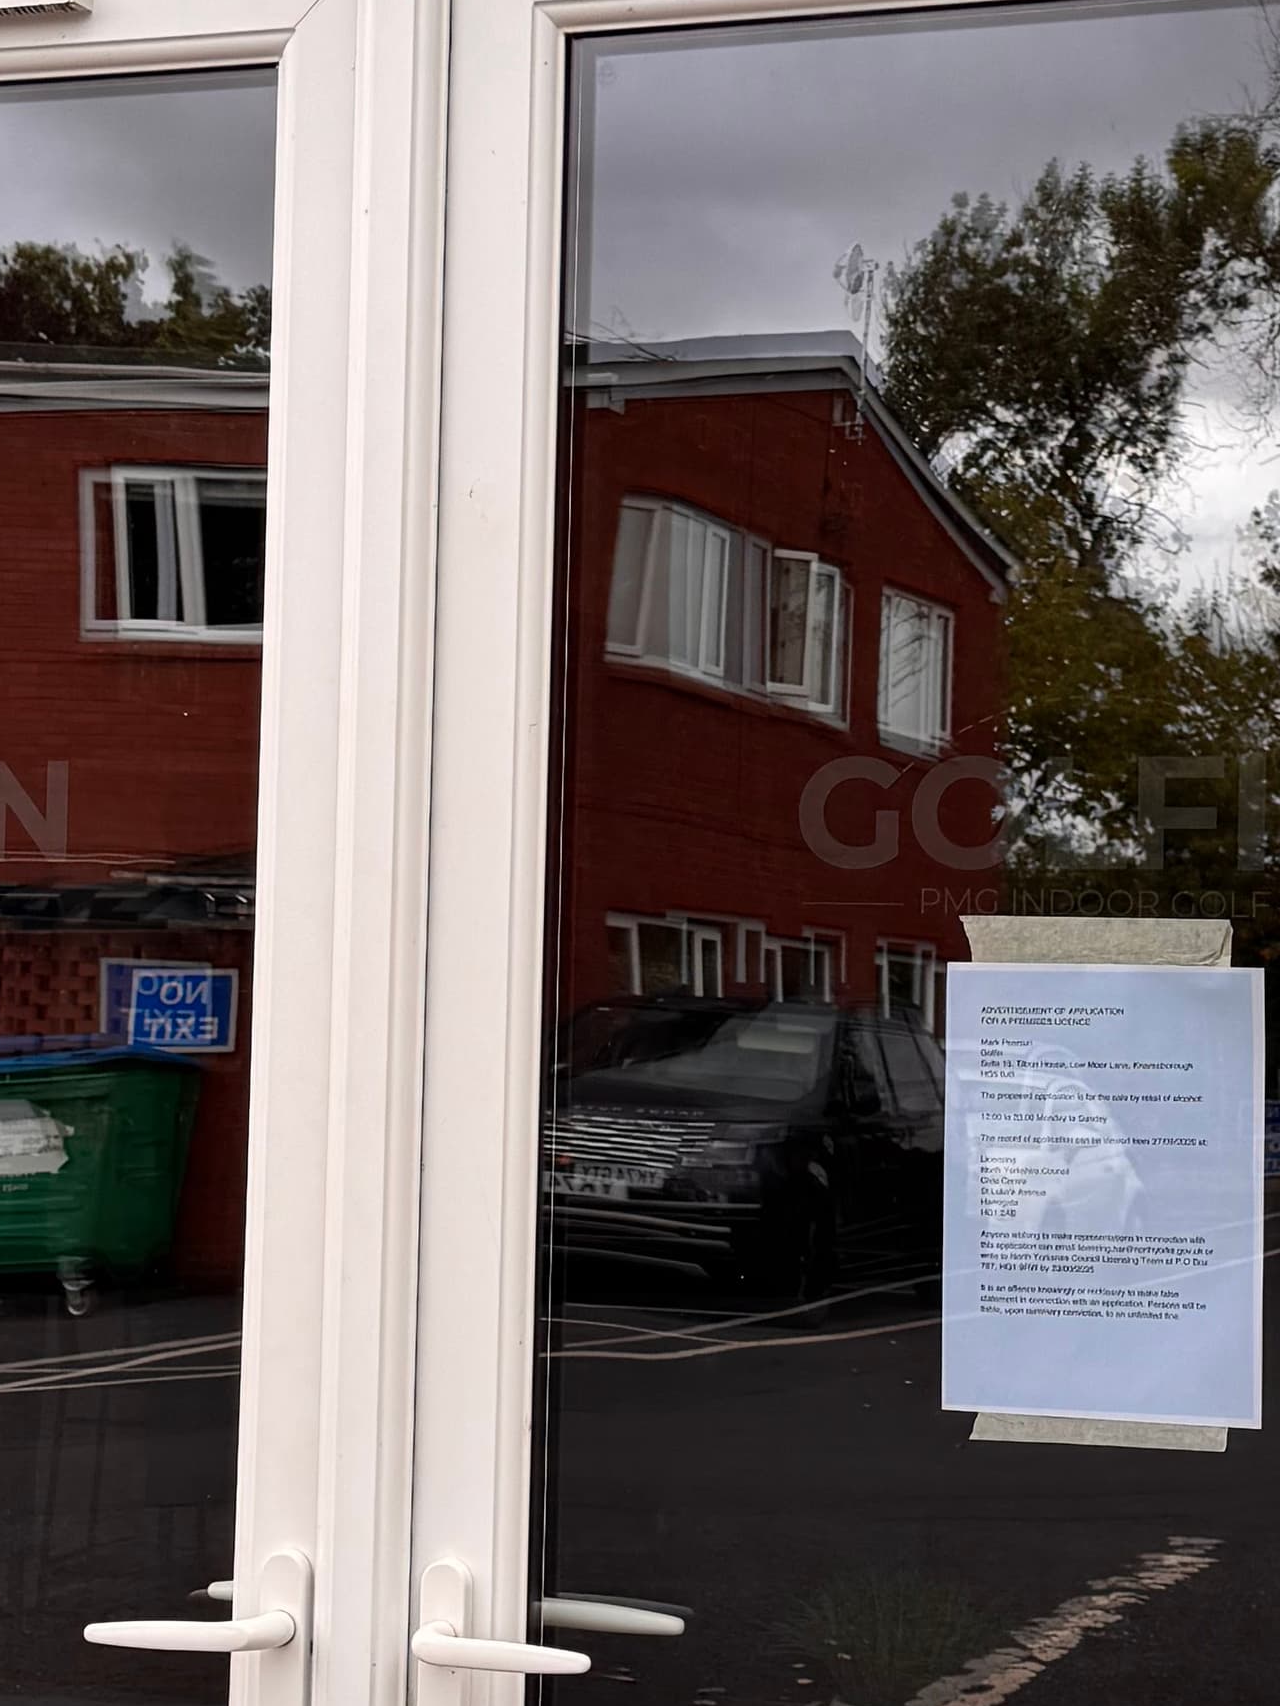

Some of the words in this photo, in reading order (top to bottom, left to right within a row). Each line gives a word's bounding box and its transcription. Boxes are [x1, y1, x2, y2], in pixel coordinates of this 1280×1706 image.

[920, 888, 999, 915] PMG
[1012, 889, 1159, 917] INDOOR
[1172, 891, 1272, 918] GOLF
